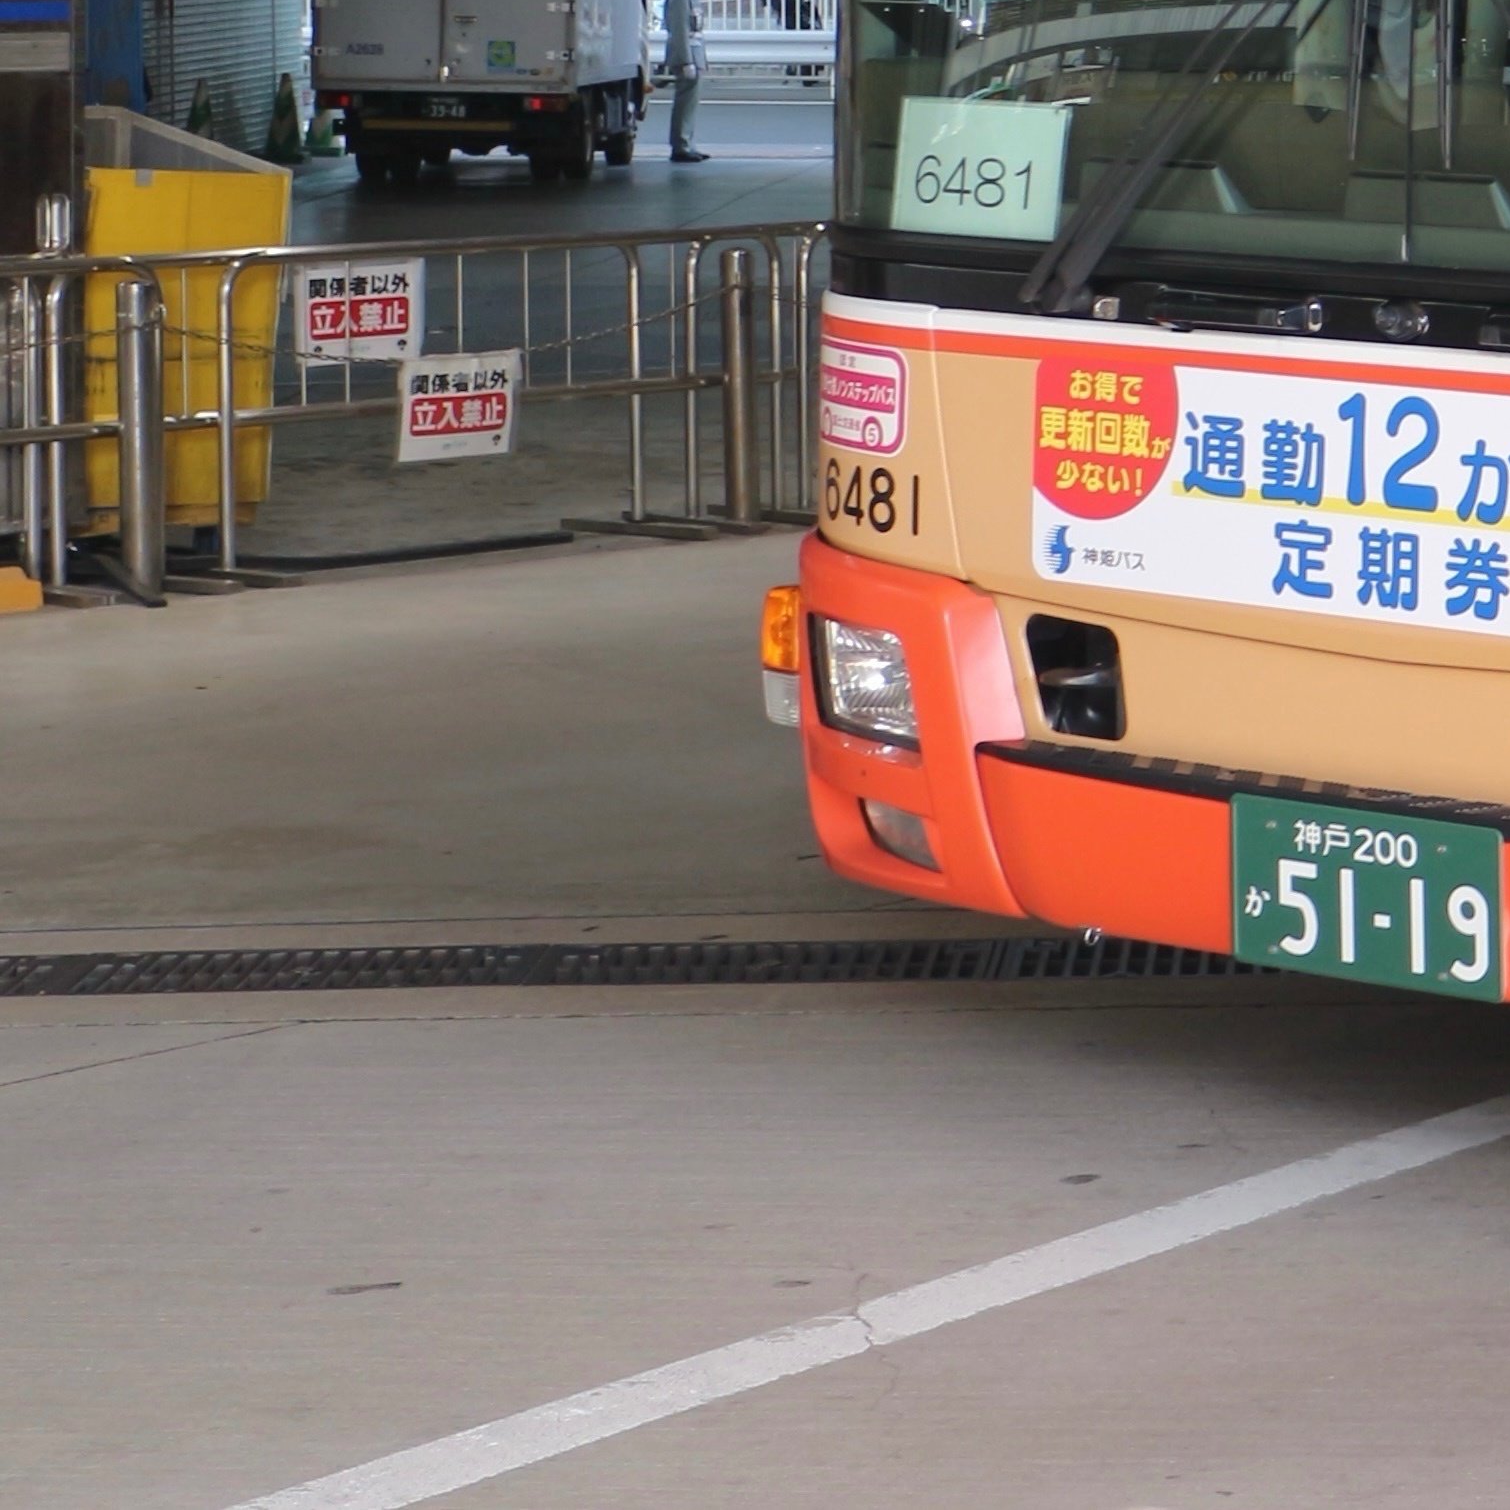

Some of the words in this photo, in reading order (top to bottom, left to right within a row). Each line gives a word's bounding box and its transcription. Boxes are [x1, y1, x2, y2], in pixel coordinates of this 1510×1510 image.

[915, 154, 1032, 210] 6481
[309, 273, 409, 300] 関係者以外
[312, 301, 407, 335] 立入禁止
[410, 369, 508, 395] 関係者以外
[1069, 370, 1144, 405] お得で
[412, 396, 504, 431] 立入禁止
[868, 427, 877, 443] 5
[1040, 406, 1172, 460] 更新回数が
[825, 457, 919, 536] 6481
[1082, 547, 1146, 571] 神姫バス
[1272, 519, 1510, 622] 定期券
[1244, 886, 1271, 918] か
[1278, 858, 1489, 983] 51-19
